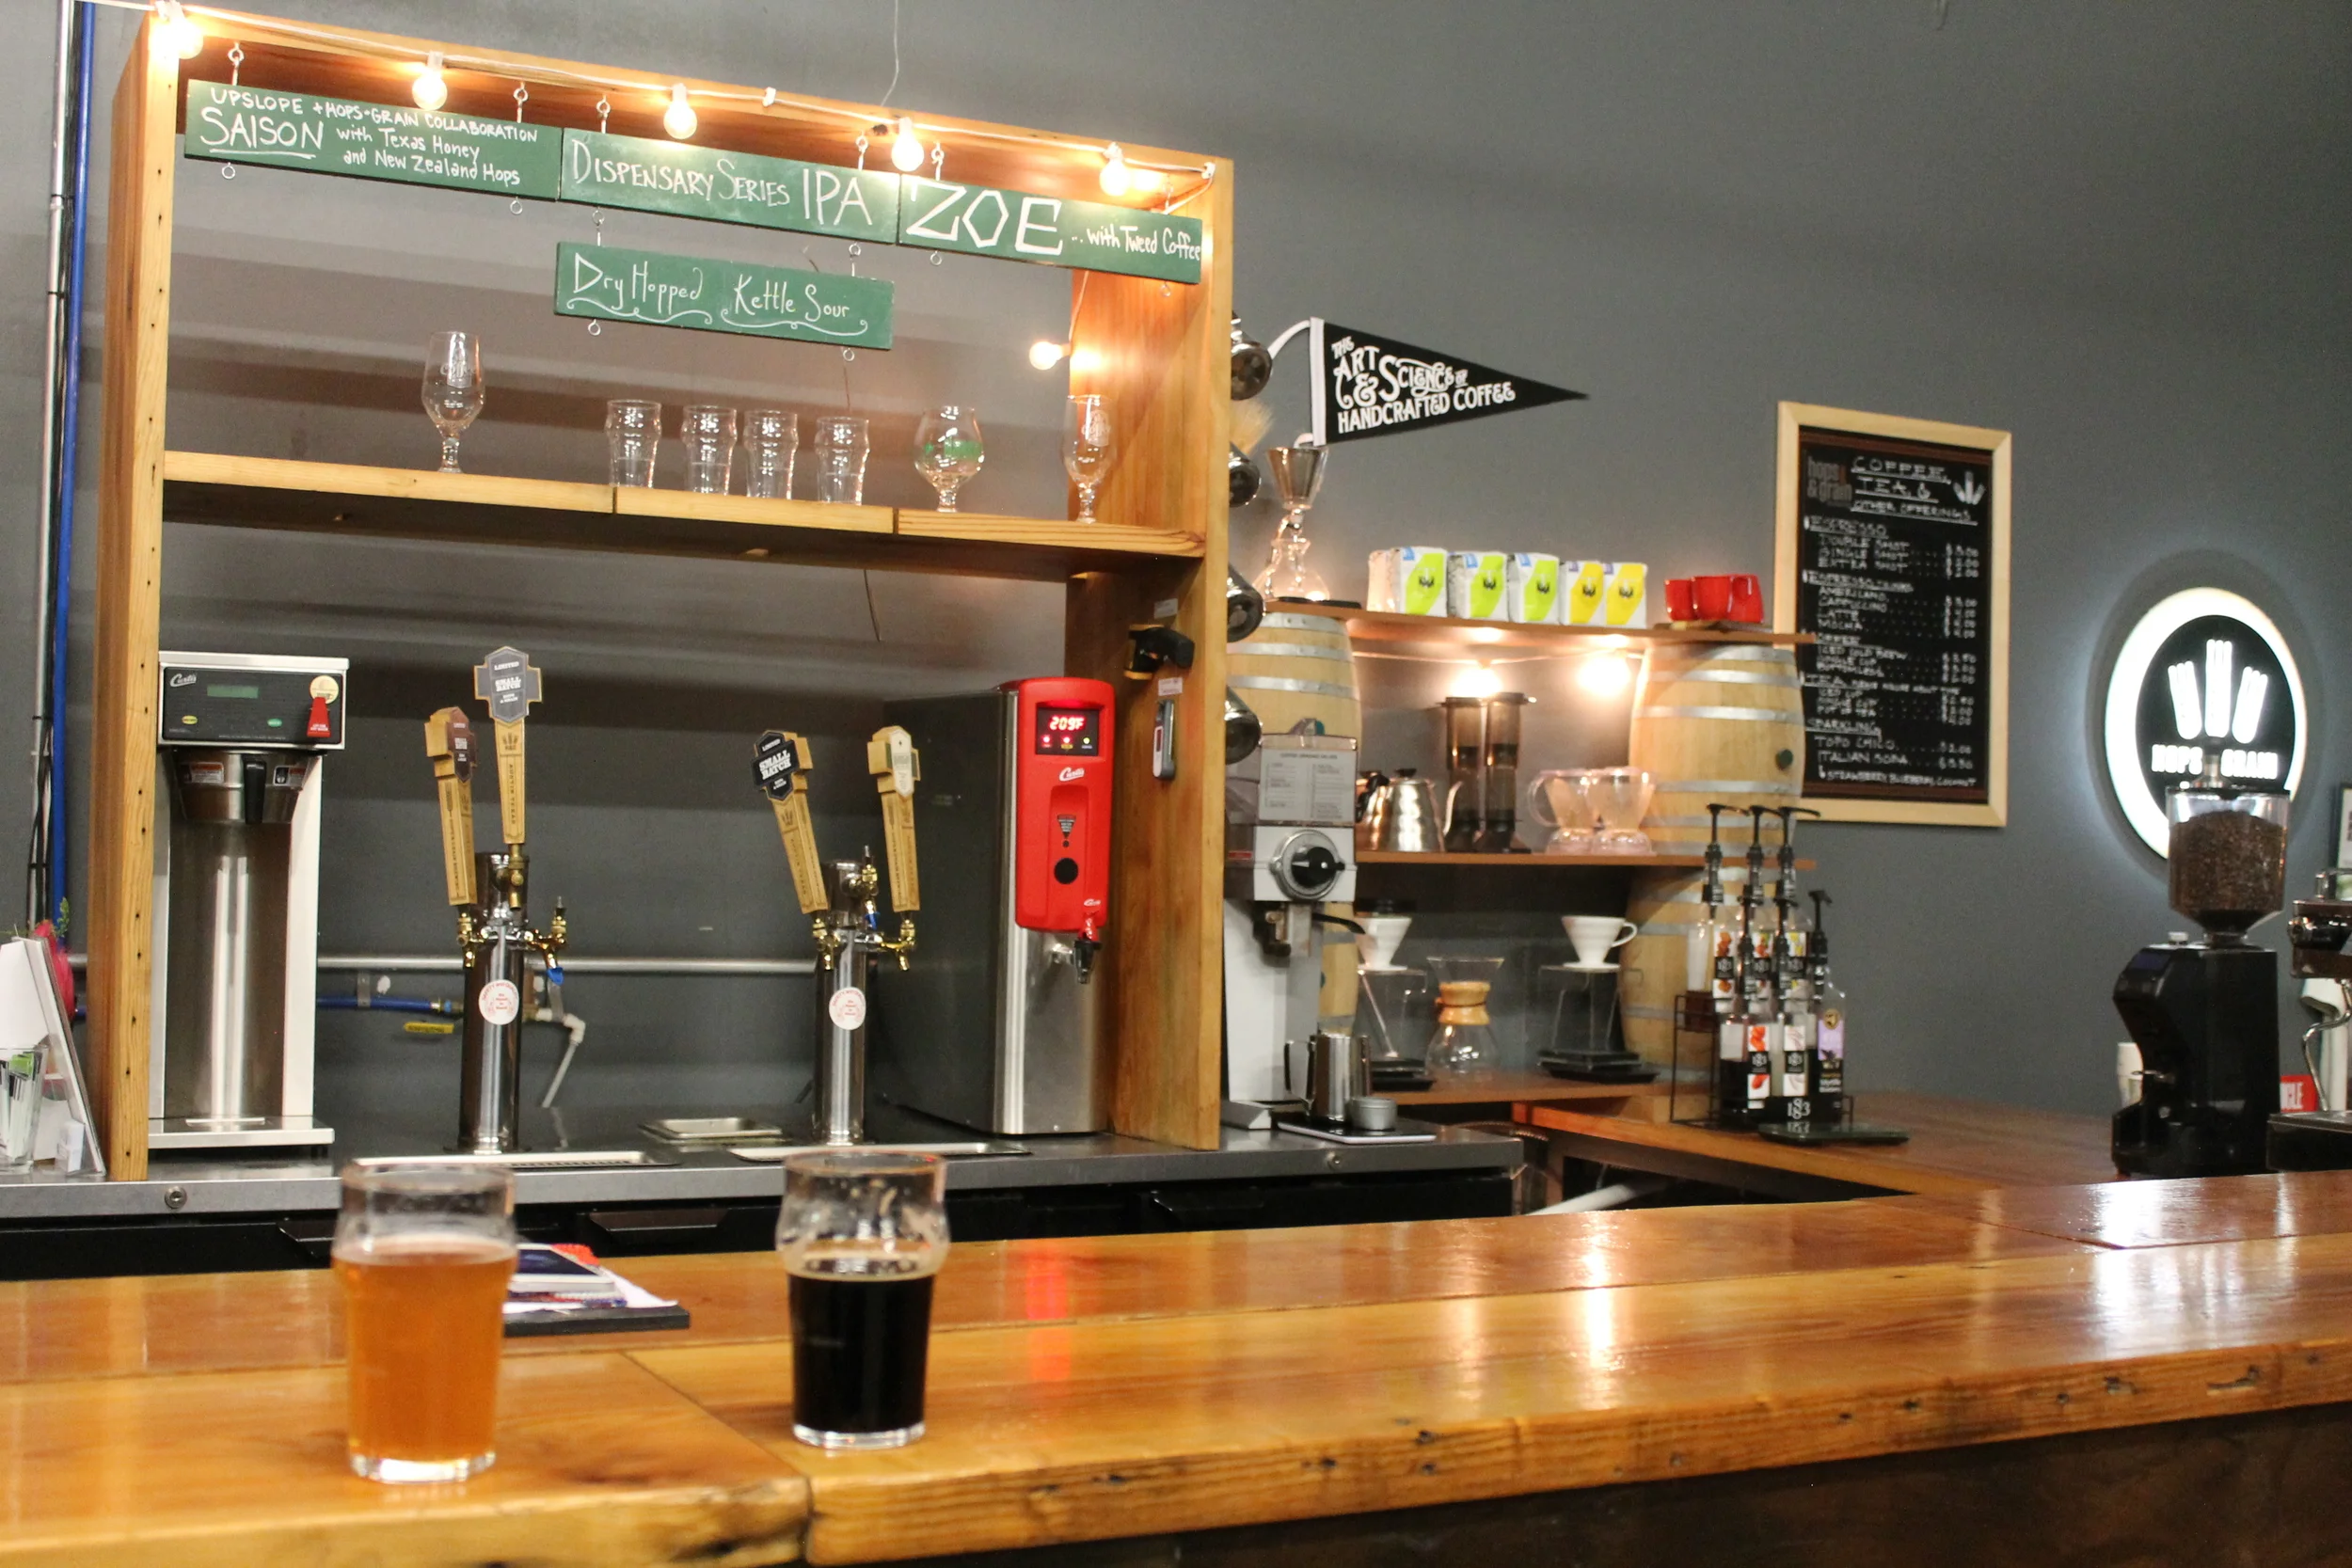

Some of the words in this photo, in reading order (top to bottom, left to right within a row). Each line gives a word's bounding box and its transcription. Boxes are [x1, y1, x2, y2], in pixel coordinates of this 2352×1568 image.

[199, 106, 324, 150] SAISON
[210, 87, 303, 115] UPSLOPE
[423, 112, 538, 143] COLLABORATION
[336, 124, 373, 143] with
[378, 126, 429, 151] Texas
[432, 136, 480, 165] Honey
[343, 148, 366, 166] and
[374, 153, 406, 171] New
[411, 155, 478, 178] Zealand
[483, 166, 520, 185] Hops
[802, 167, 873, 226] IPA
[905, 179, 1064, 256] ZOE
[1119, 226, 1158, 254] Tweed
[1162, 227, 1201, 261] Coffee
[573, 252, 624, 310] Dry
[631, 261, 704, 315] Hopped
[734, 273, 796, 316] Kettle
[804, 284, 850, 323] Sour
[1331, 336, 1355, 359] THE
[1377, 354, 1454, 403] SCIENCE
[1337, 392, 1450, 434] HANDCRAFTED
[1453, 381, 1516, 411] COFFEE
